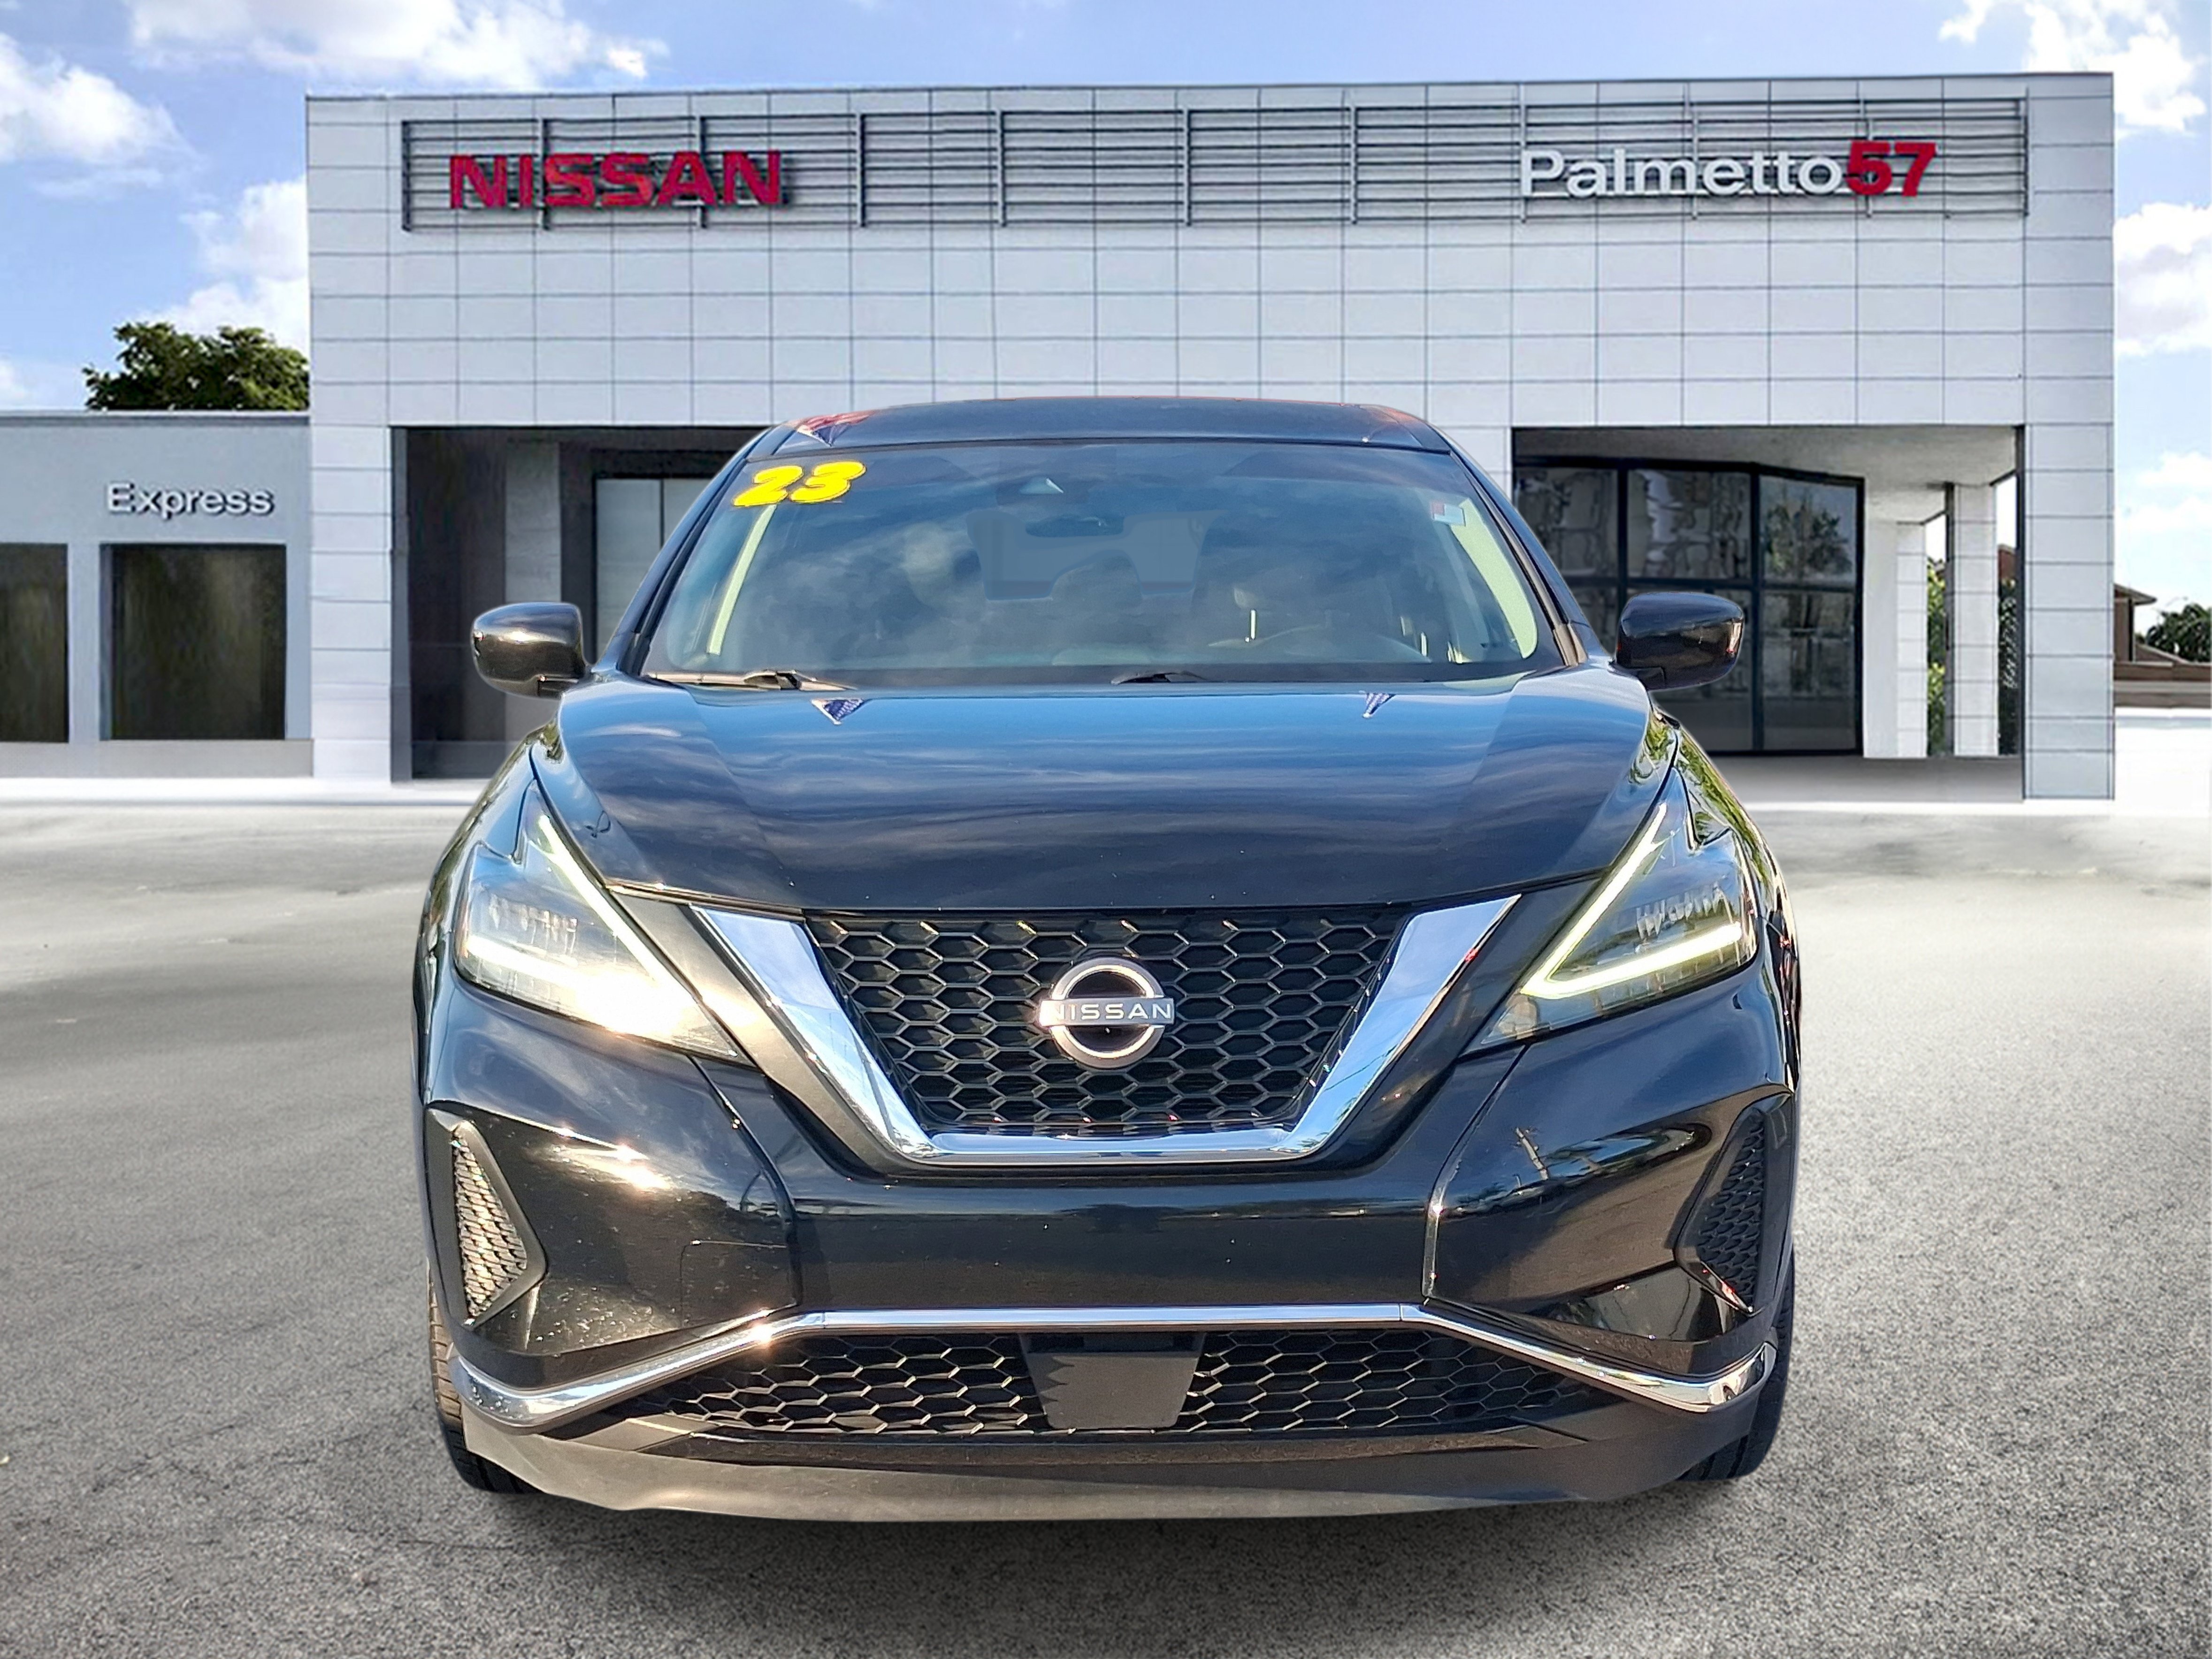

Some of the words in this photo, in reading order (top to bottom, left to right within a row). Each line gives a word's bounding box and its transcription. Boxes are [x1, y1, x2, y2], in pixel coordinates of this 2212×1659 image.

[450, 151, 781, 209] NISSAN
[107, 482, 276, 520] Express
[733, 461, 865, 507] 23
